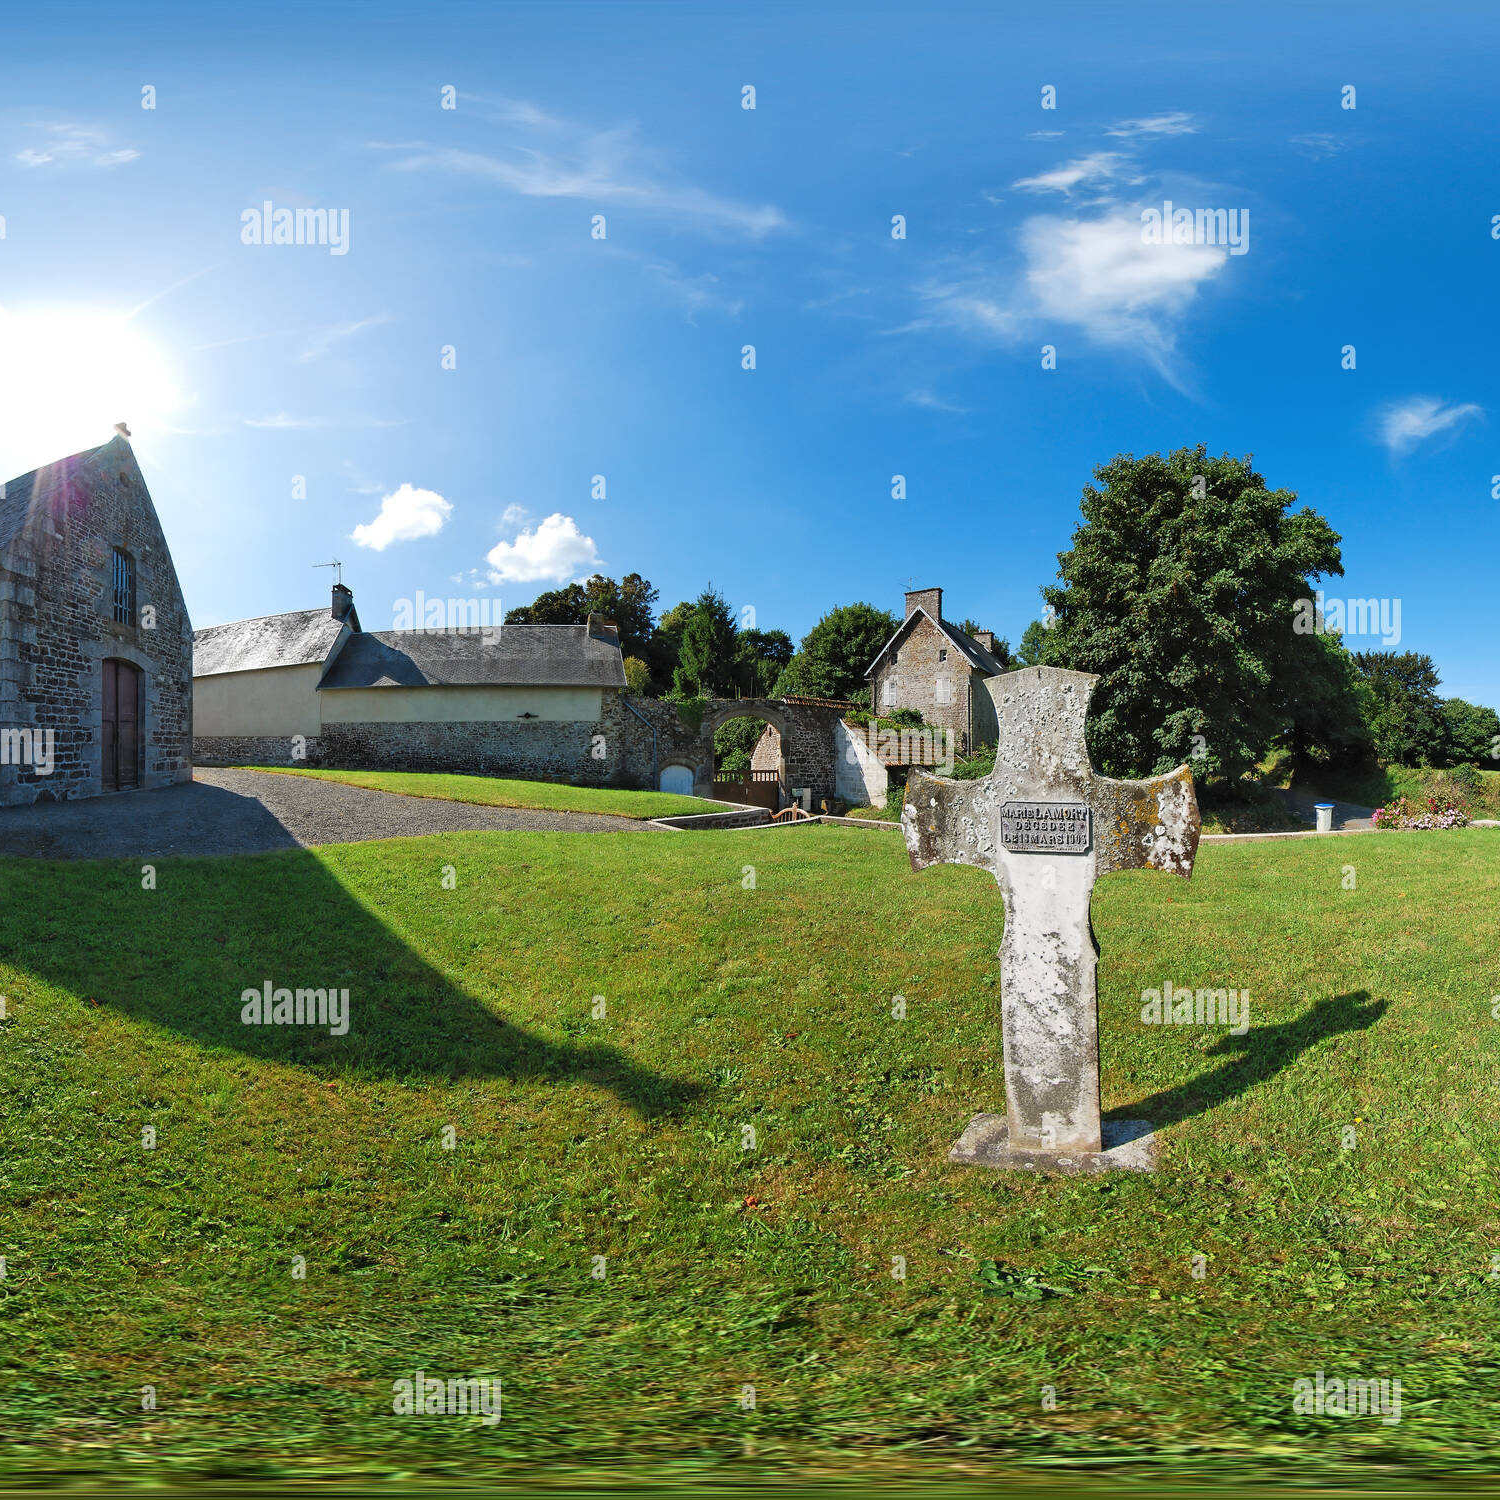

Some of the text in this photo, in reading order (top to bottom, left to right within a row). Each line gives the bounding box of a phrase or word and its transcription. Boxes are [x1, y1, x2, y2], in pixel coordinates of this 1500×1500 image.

[1002, 808, 1087, 820] MARIE LAMORT
[1005, 834, 1018, 843] LE
[1031, 834, 1064, 844] MARS
